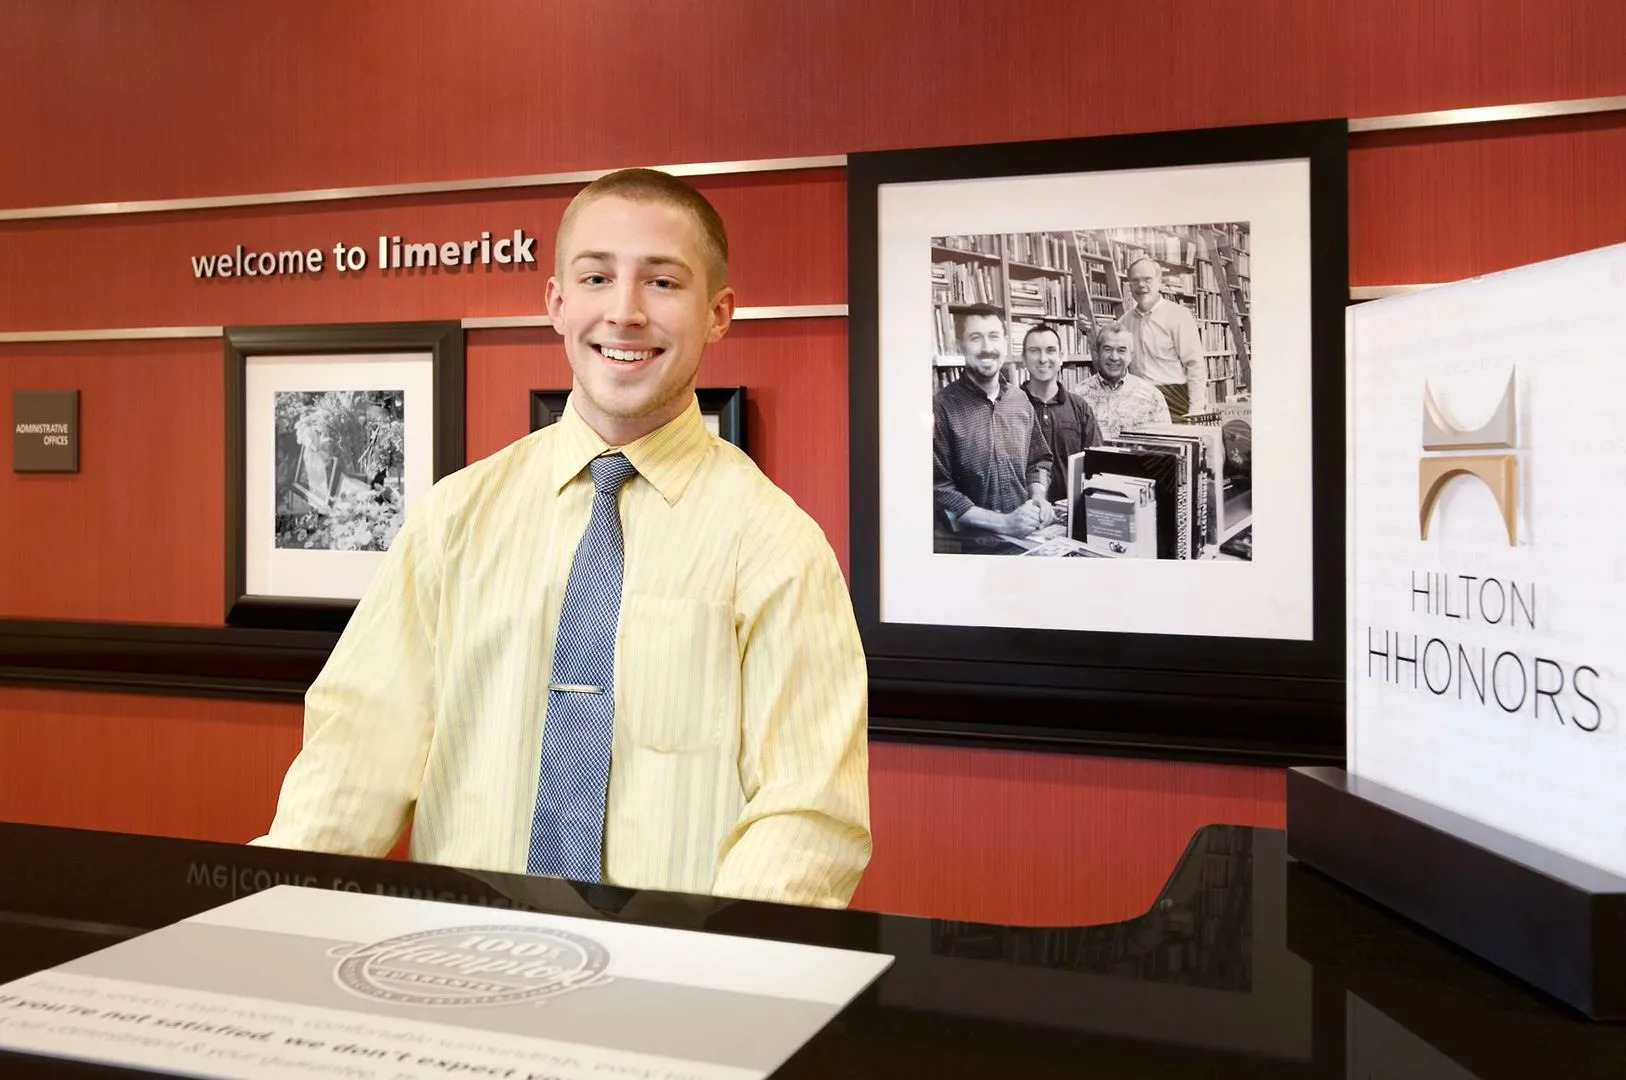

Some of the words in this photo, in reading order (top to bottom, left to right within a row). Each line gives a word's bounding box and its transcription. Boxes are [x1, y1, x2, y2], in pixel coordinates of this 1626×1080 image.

[191, 245, 322, 278] welcome
[332, 242, 366, 271] to
[378, 229, 535, 269] limerick
[16, 424, 68, 433] ADMINISTRATIVE
[43, 435, 68, 445] OFFICES
[1412, 570, 1535, 629] HILTON
[1368, 626, 1602, 732] HHONORS
[325, 943, 615, 987] Hampton
[100, 1011, 152, 1024] not
[284, 1036, 325, 1050] we
[331, 1043, 411, 1062] don't
[416, 1056, 517, 1079] expect
